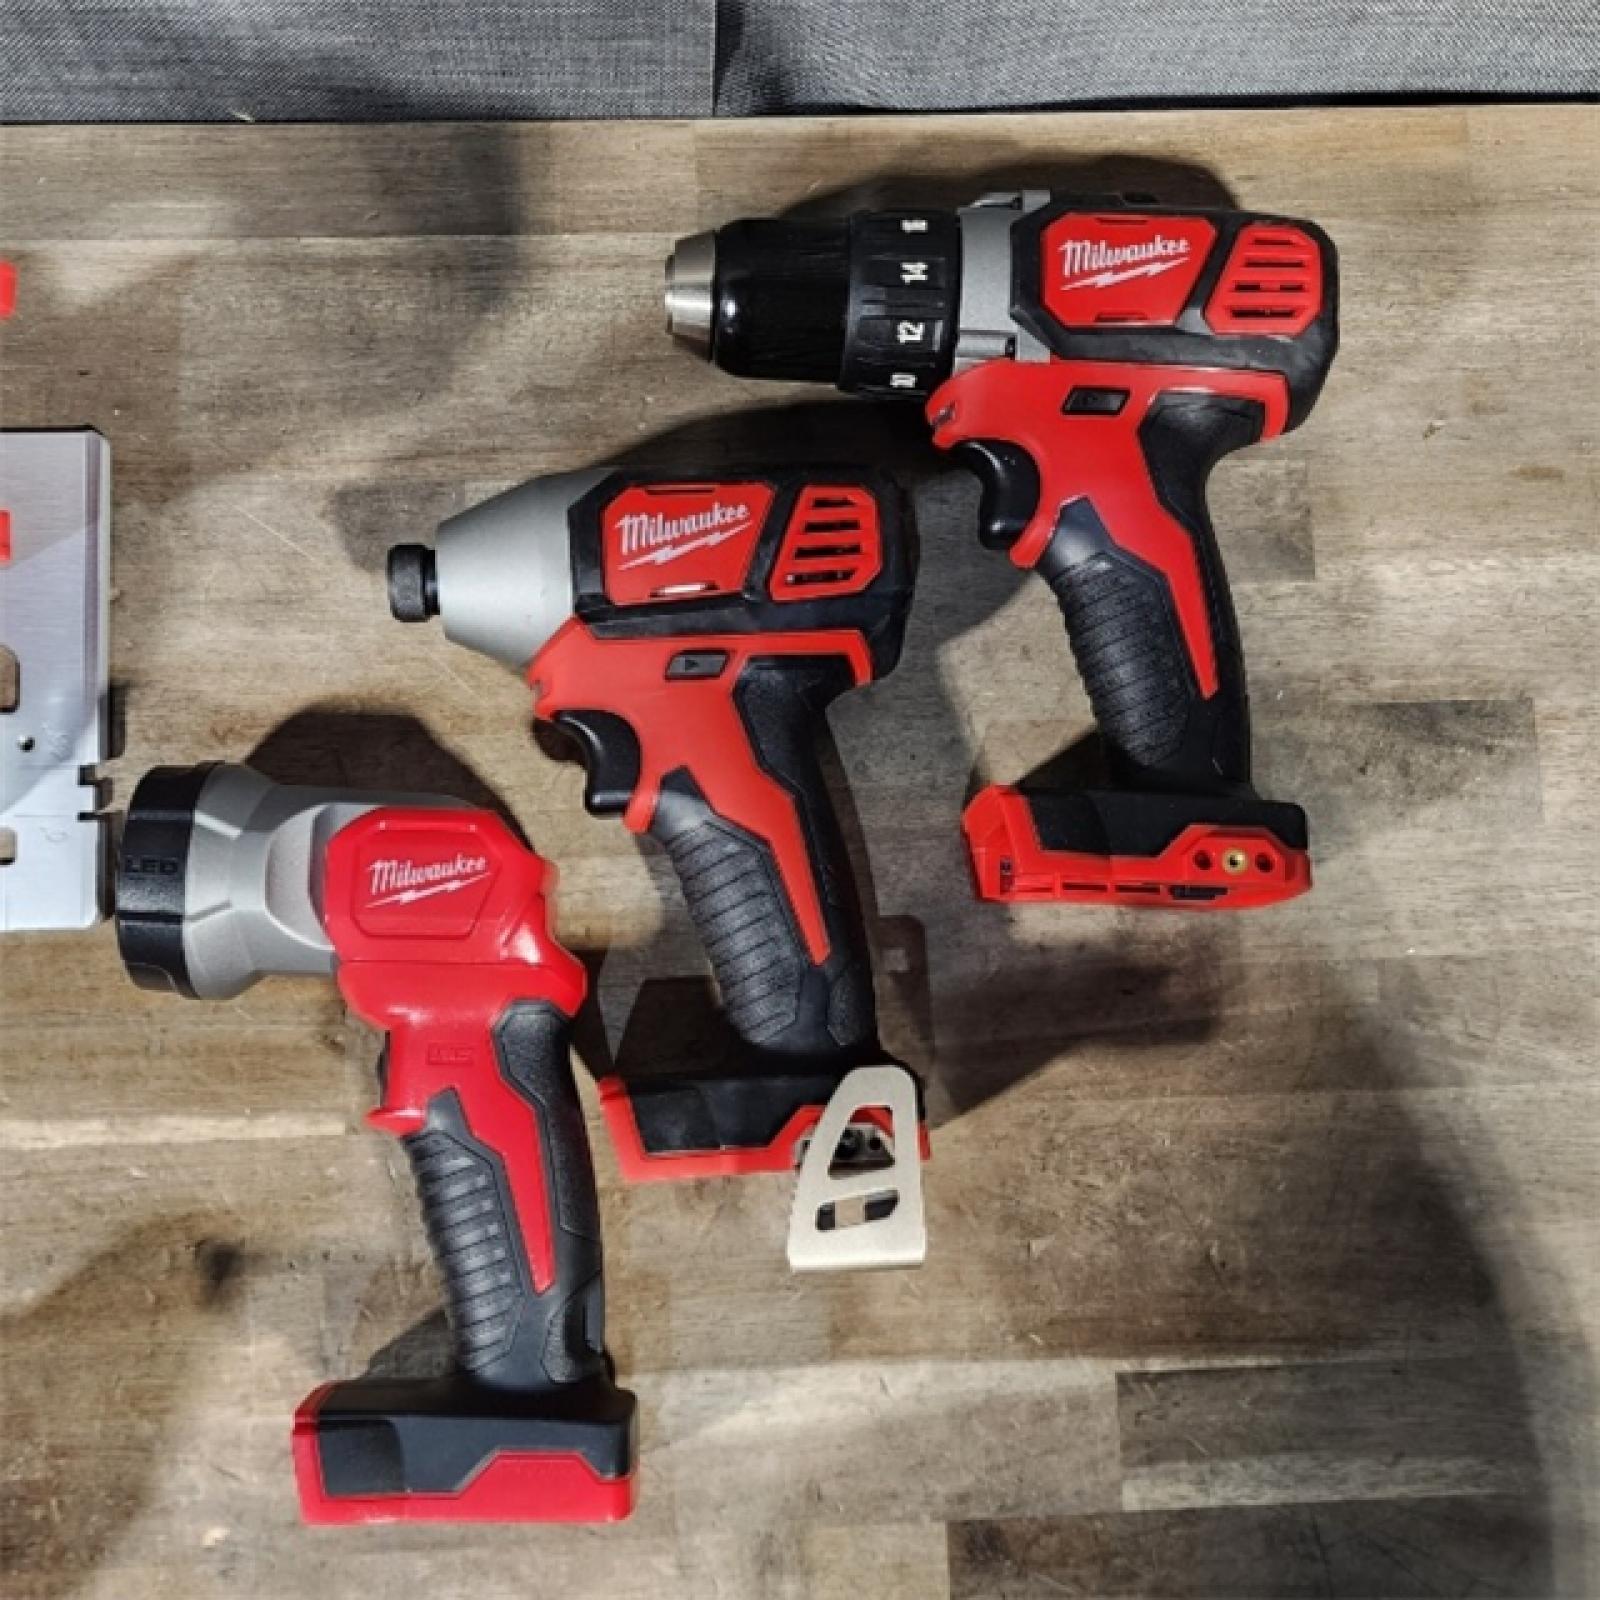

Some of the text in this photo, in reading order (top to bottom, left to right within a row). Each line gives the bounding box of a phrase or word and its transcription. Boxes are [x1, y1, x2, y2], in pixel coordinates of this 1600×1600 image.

[901, 262, 928, 284] 14
[1059, 235, 1191, 277] Milwaukee
[897, 320, 925, 343] 12
[615, 502, 750, 555] Milwaukee
[368, 852, 486, 896] Milwaukee
